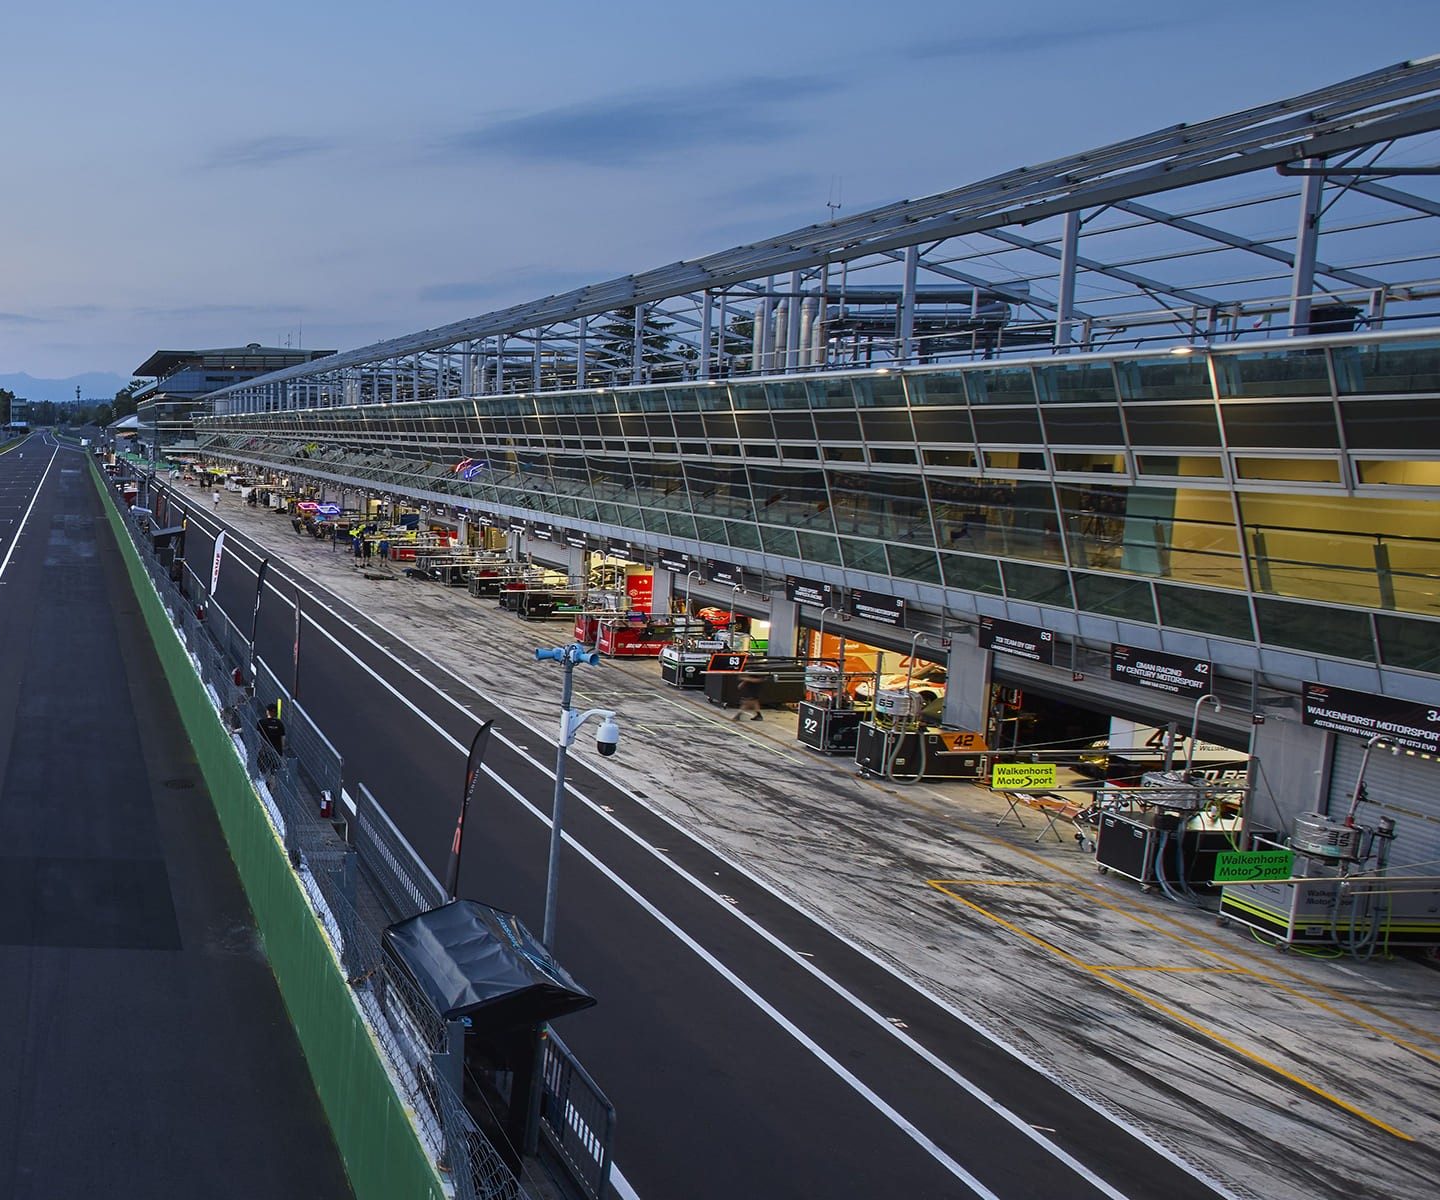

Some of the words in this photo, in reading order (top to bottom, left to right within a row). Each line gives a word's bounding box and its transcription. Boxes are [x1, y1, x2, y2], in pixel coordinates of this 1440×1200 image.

[1040, 631, 1052, 642] 63
[729, 656, 740, 666] 63
[1136, 661, 1156, 671] OMAN
[1156, 665, 1183, 677] RACING
[1194, 663, 1209, 674] 42
[1116, 664, 1126, 672] BY
[1126, 666, 1156, 679] CENTURY
[1156, 673, 1205, 689] MOTORSPORT
[1307, 705, 1376, 728] WALKENHORST
[804, 718, 818, 732] 92
[1314, 719, 1335, 730] ASTON
[1335, 723, 1359, 735] MARTIN
[953, 735, 975, 747] 42
[997, 767, 1053, 775] Walkenhorst
[1221, 854, 1289, 865] Walkenhorst
